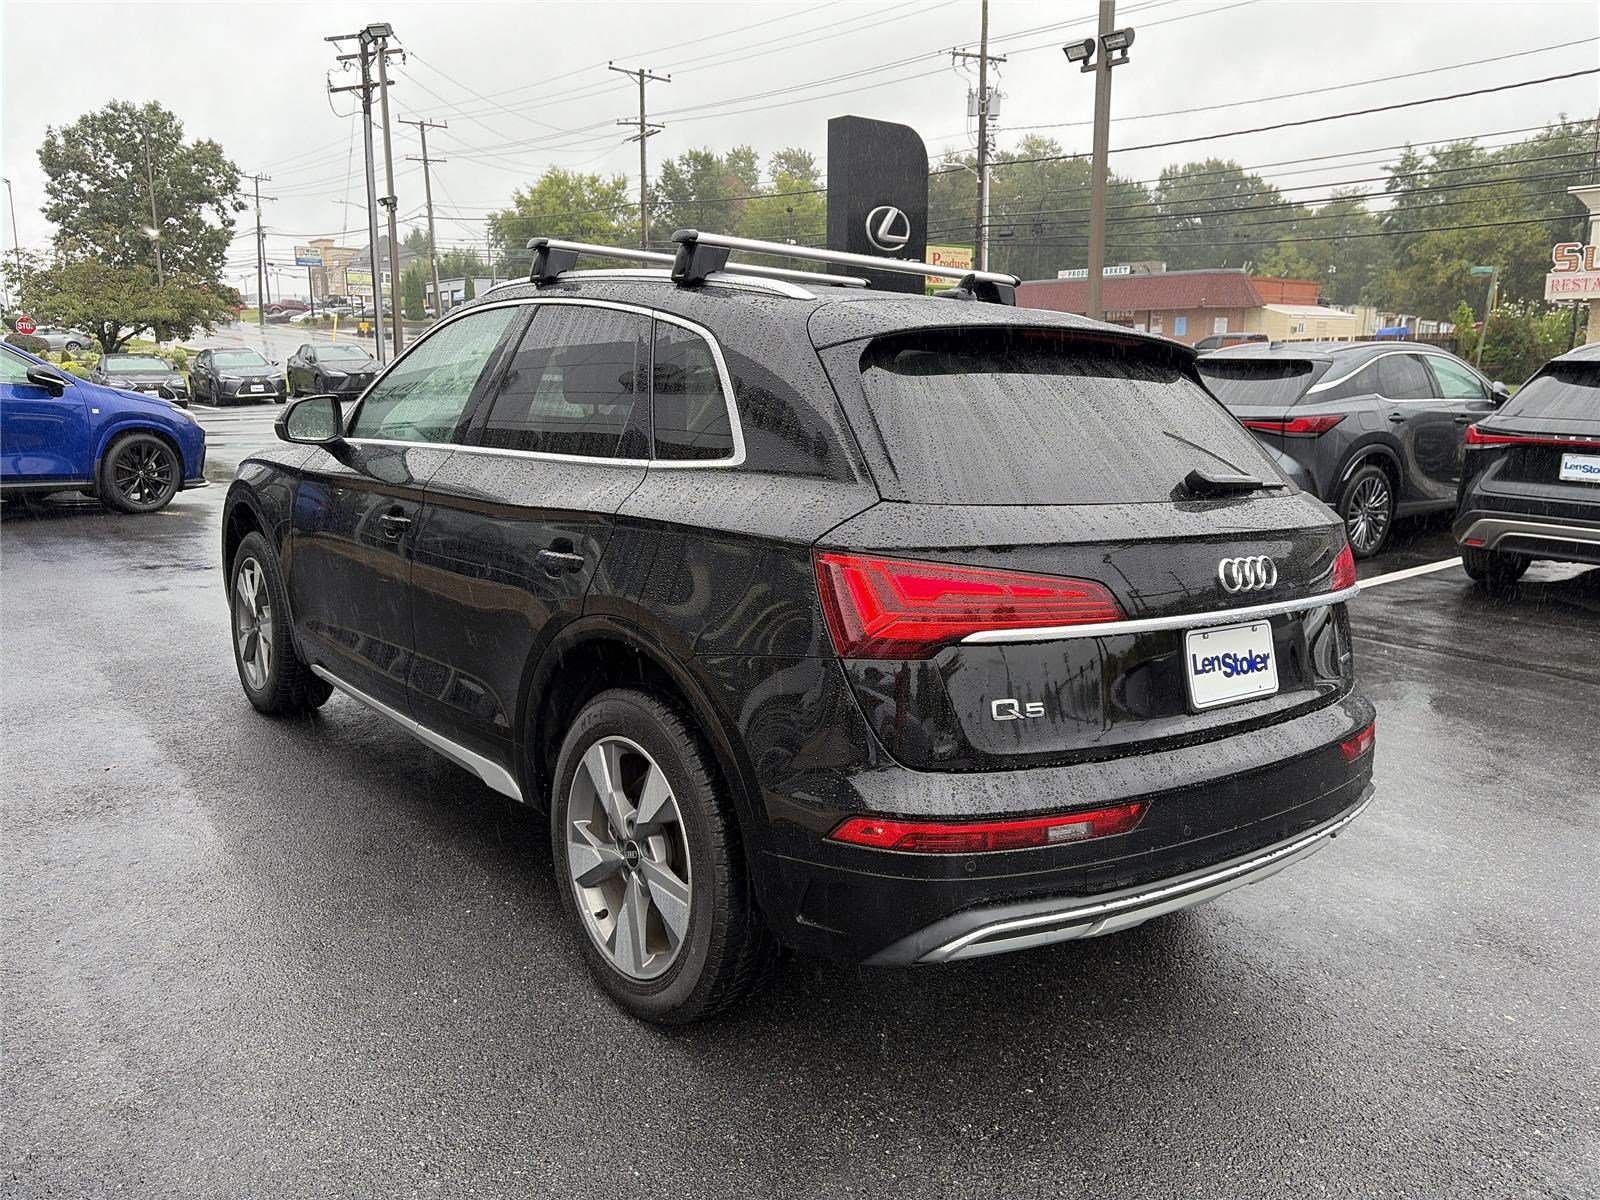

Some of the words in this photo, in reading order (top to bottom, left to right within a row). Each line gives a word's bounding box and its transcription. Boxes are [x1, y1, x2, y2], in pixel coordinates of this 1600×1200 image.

[932, 252, 970, 269] Produce
[1104, 266, 1128, 275] ARKET
[17, 322, 33, 330] STO
[1192, 649, 1270, 678] LenStoler
[992, 699, 1044, 721] Q5
